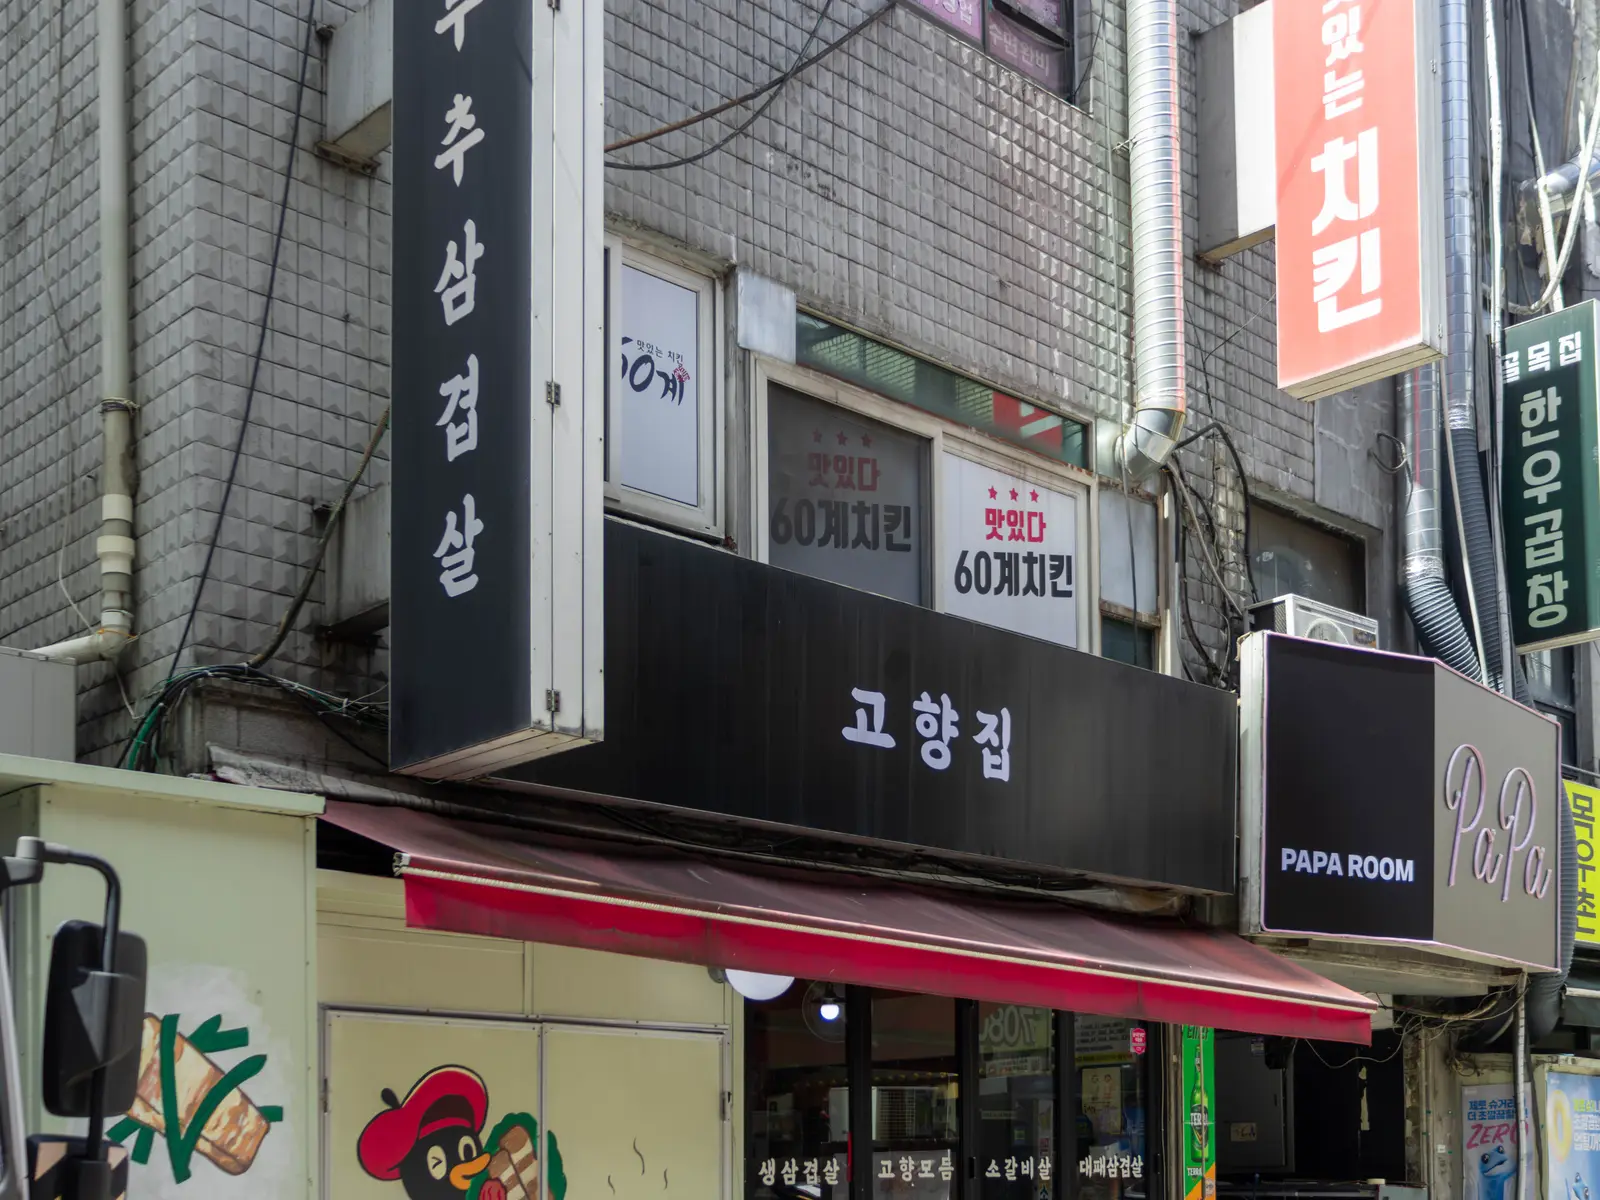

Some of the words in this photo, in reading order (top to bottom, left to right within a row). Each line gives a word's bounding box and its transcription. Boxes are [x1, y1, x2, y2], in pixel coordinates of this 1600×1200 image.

[1321, 0, 1365, 121] 있는
[1310, 126, 1382, 333] 치킨
[636, 339, 663, 358] 맛있는
[667, 350, 685, 368] 치킨
[1503, 330, 1582, 384] 골목집
[806, 451, 881, 492] 맛있다
[770, 497, 912, 553] 60계치킨
[984, 507, 1047, 543] 맛있다
[1519, 385, 1569, 629] 한우곱창
[953, 549, 1074, 599] 60계치킨
[841, 686, 1012, 783] 고향집
[1280, 847, 1344, 877] PAPA
[1347, 853, 1415, 883] ROOM
[1190, 1112, 1209, 1125] TERA
[757, 1156, 840, 1186] 생삼겹살
[985, 1155, 1053, 1181] 소갈비살
[1079, 1154, 1144, 1179] 대패삼겹살
